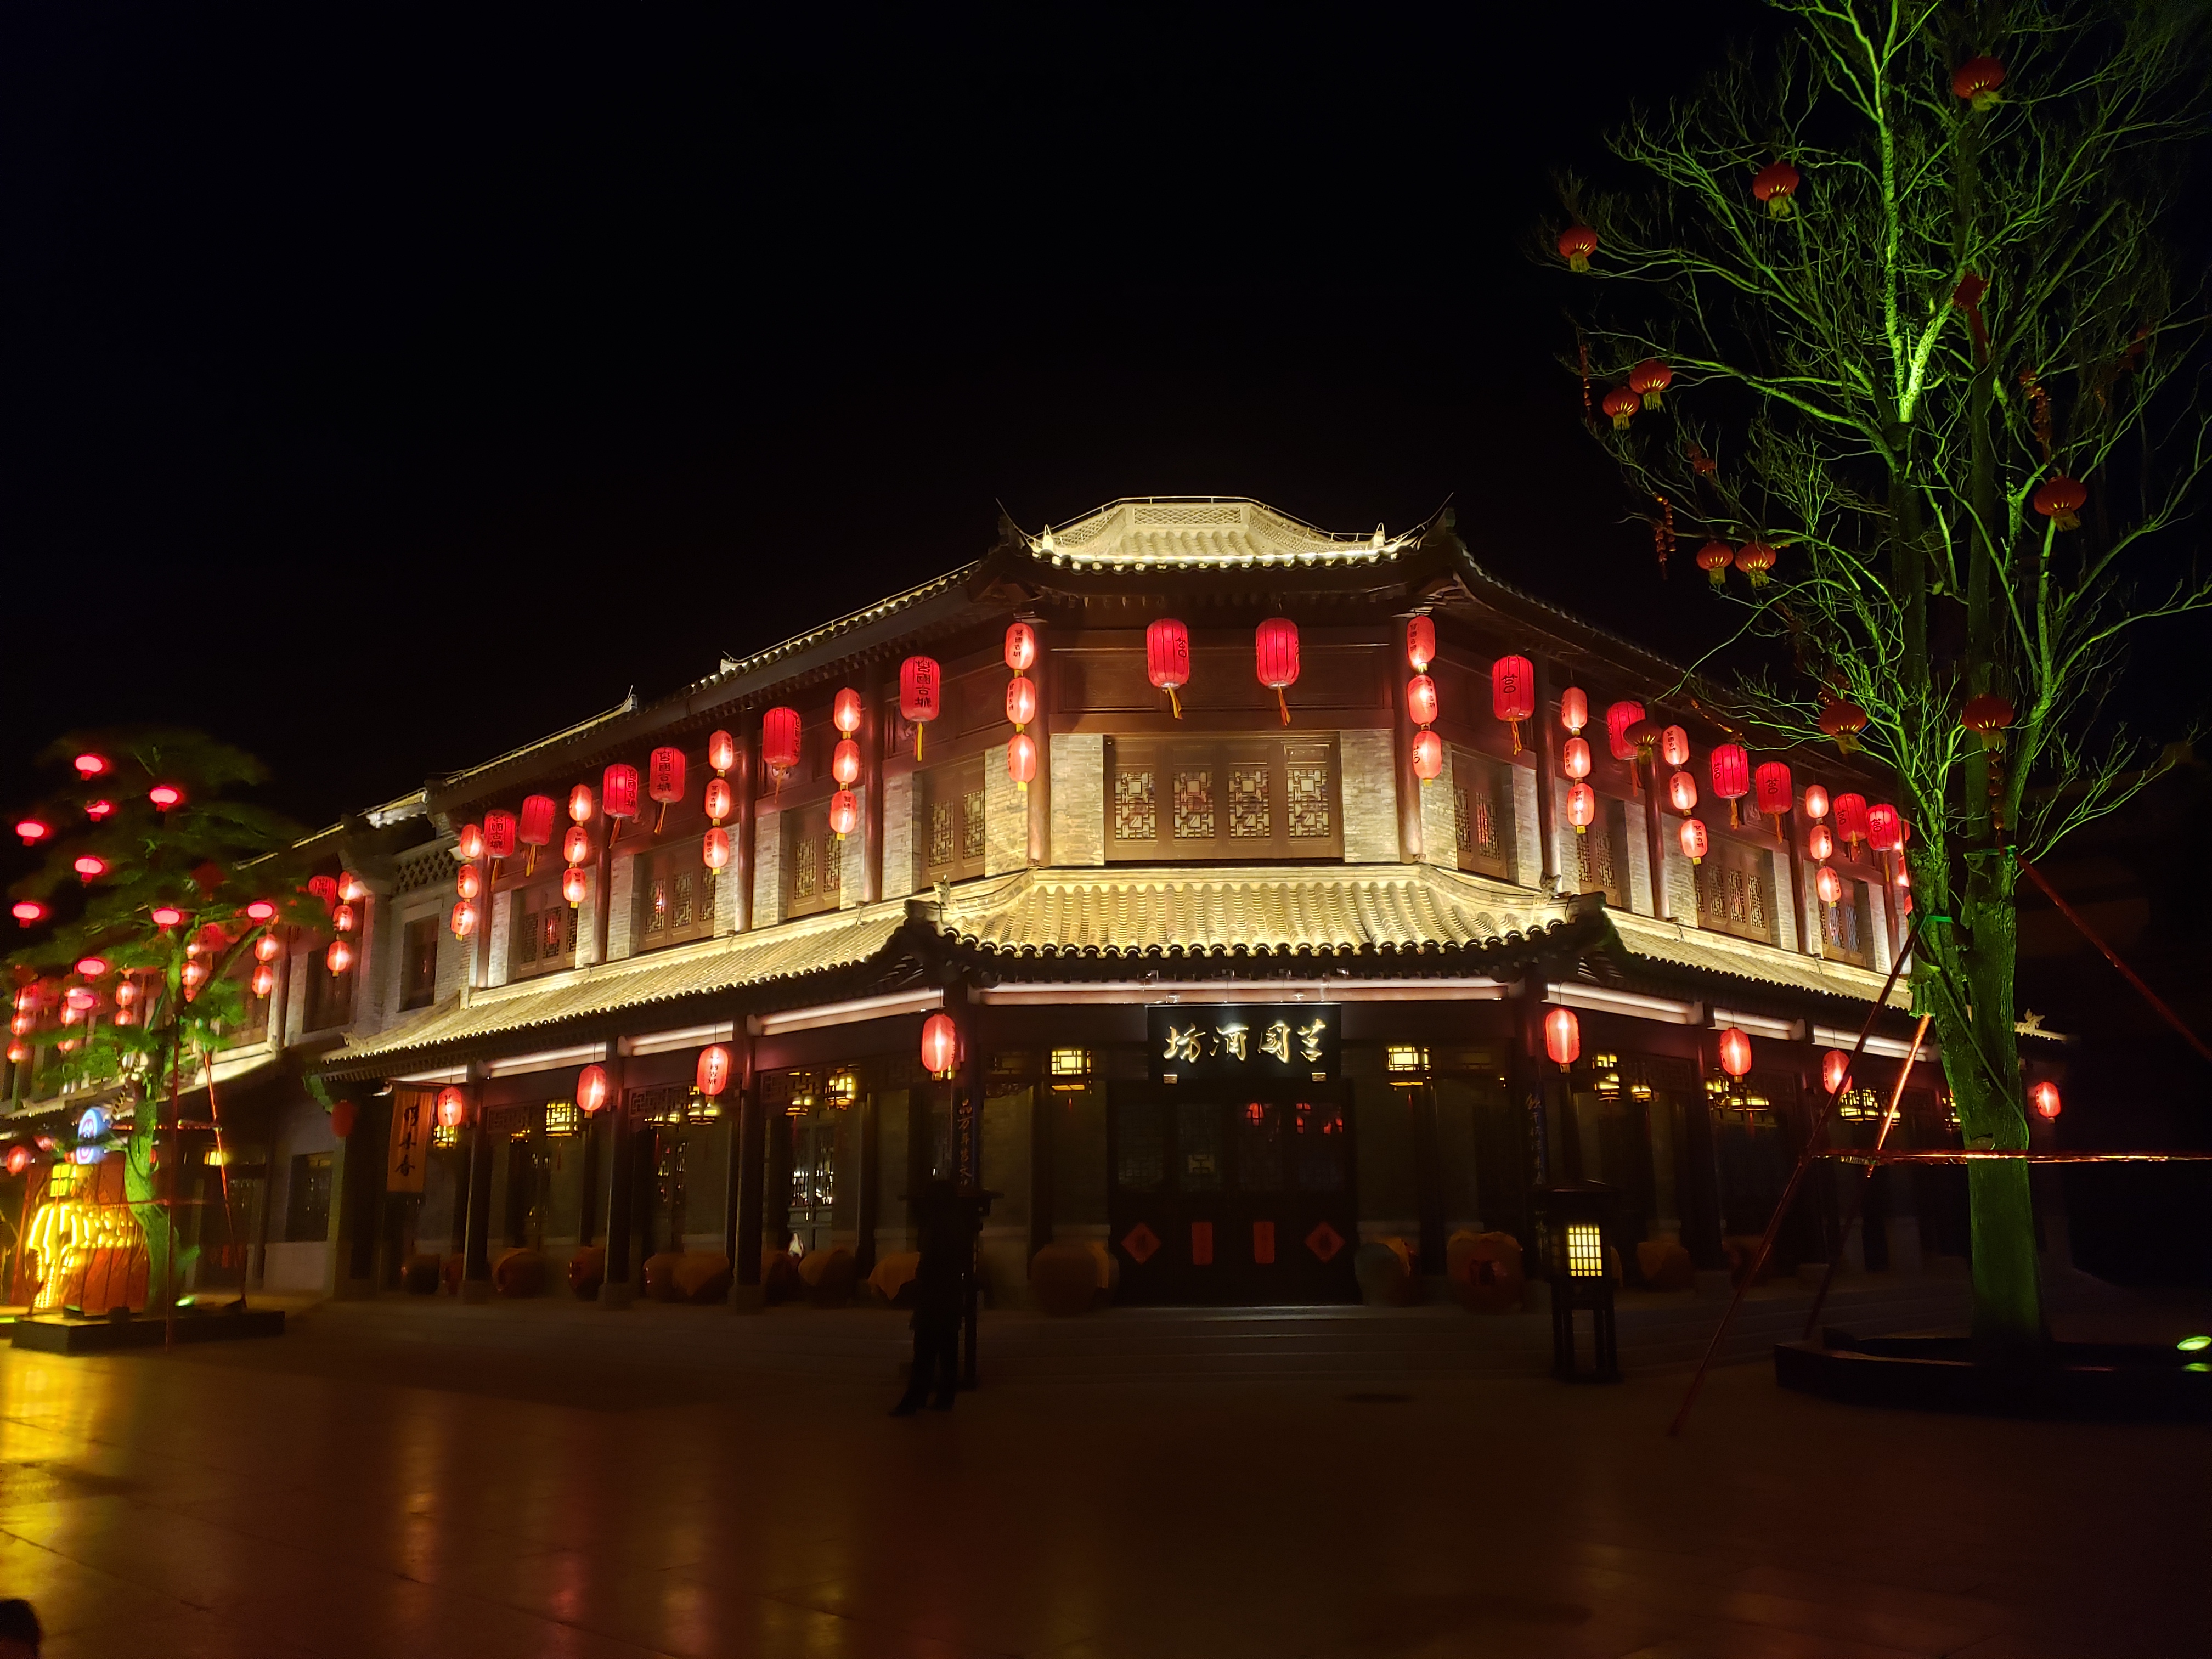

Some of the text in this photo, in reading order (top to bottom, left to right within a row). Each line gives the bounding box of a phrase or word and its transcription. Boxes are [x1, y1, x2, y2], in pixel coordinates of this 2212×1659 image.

[915, 659, 932, 708] 莒國古城
[657, 748, 672, 792] 莒國古城
